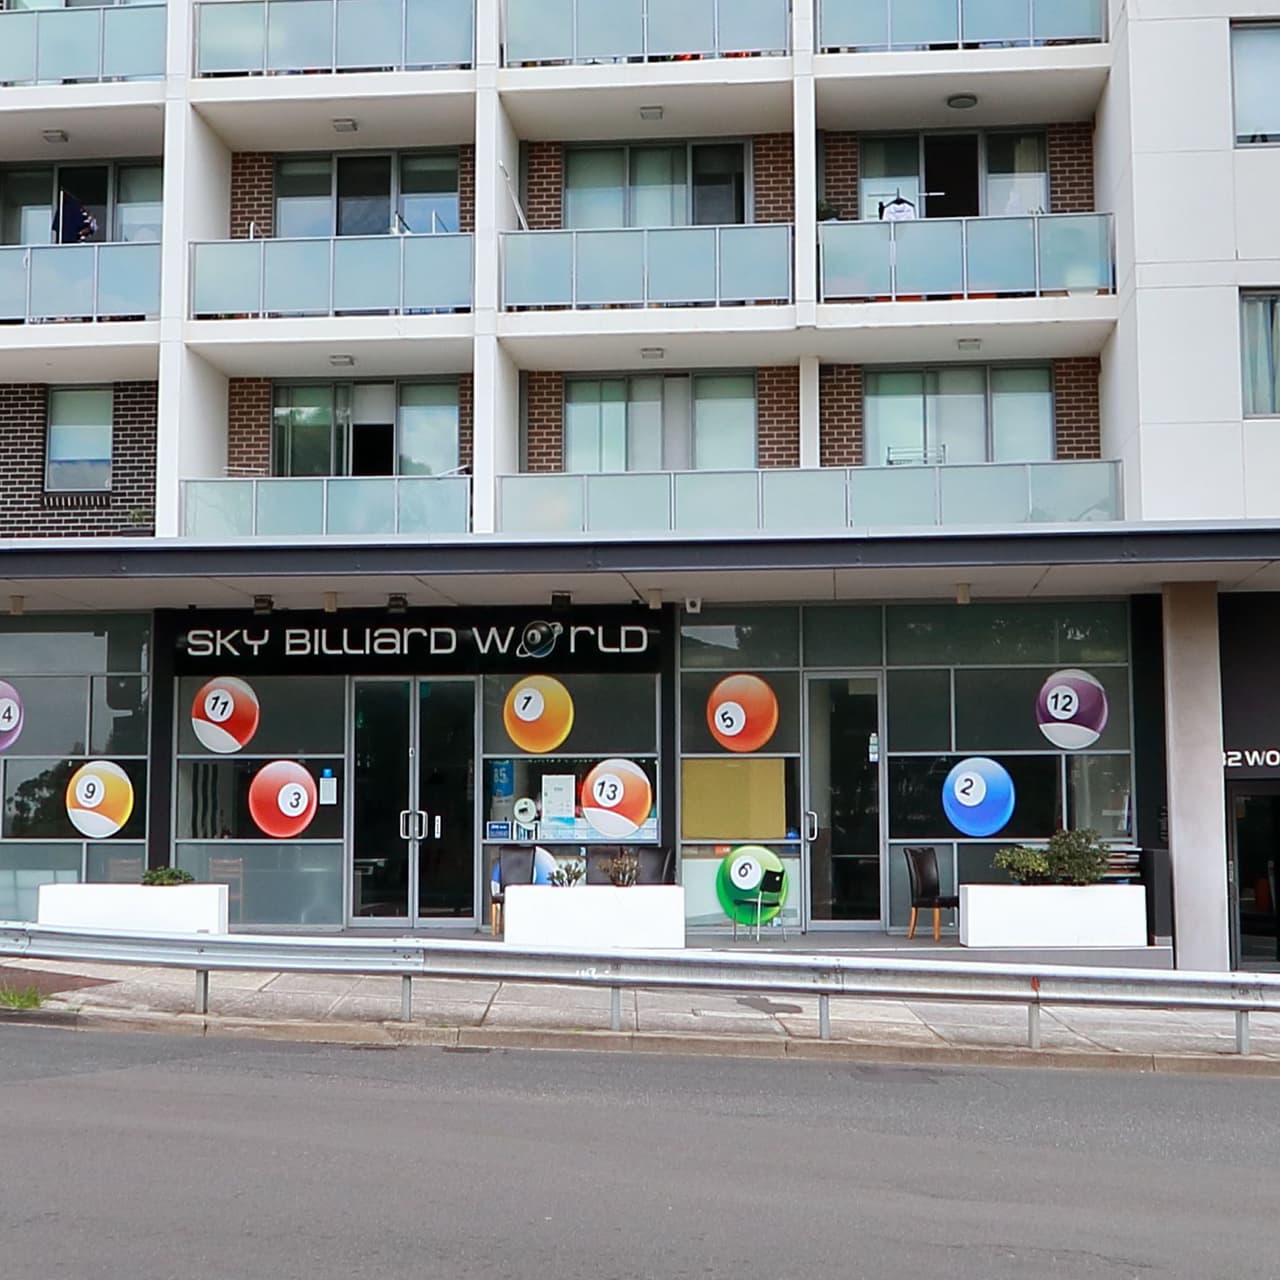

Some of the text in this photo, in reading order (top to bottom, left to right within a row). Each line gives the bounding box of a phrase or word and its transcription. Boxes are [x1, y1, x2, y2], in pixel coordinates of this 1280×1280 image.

[186, 628, 270, 656] SKY
[211, 695, 229, 716] 11
[522, 695, 532, 711] 1
[1051, 692, 1073, 712] 12
[2, 705, 13, 722] 4
[721, 711, 734, 729] 5
[84, 782, 96, 800] 9
[598, 780, 618, 801] 13
[960, 778, 974, 796] 2
[290, 792, 301, 809] 3
[738, 862, 753, 878] 6
